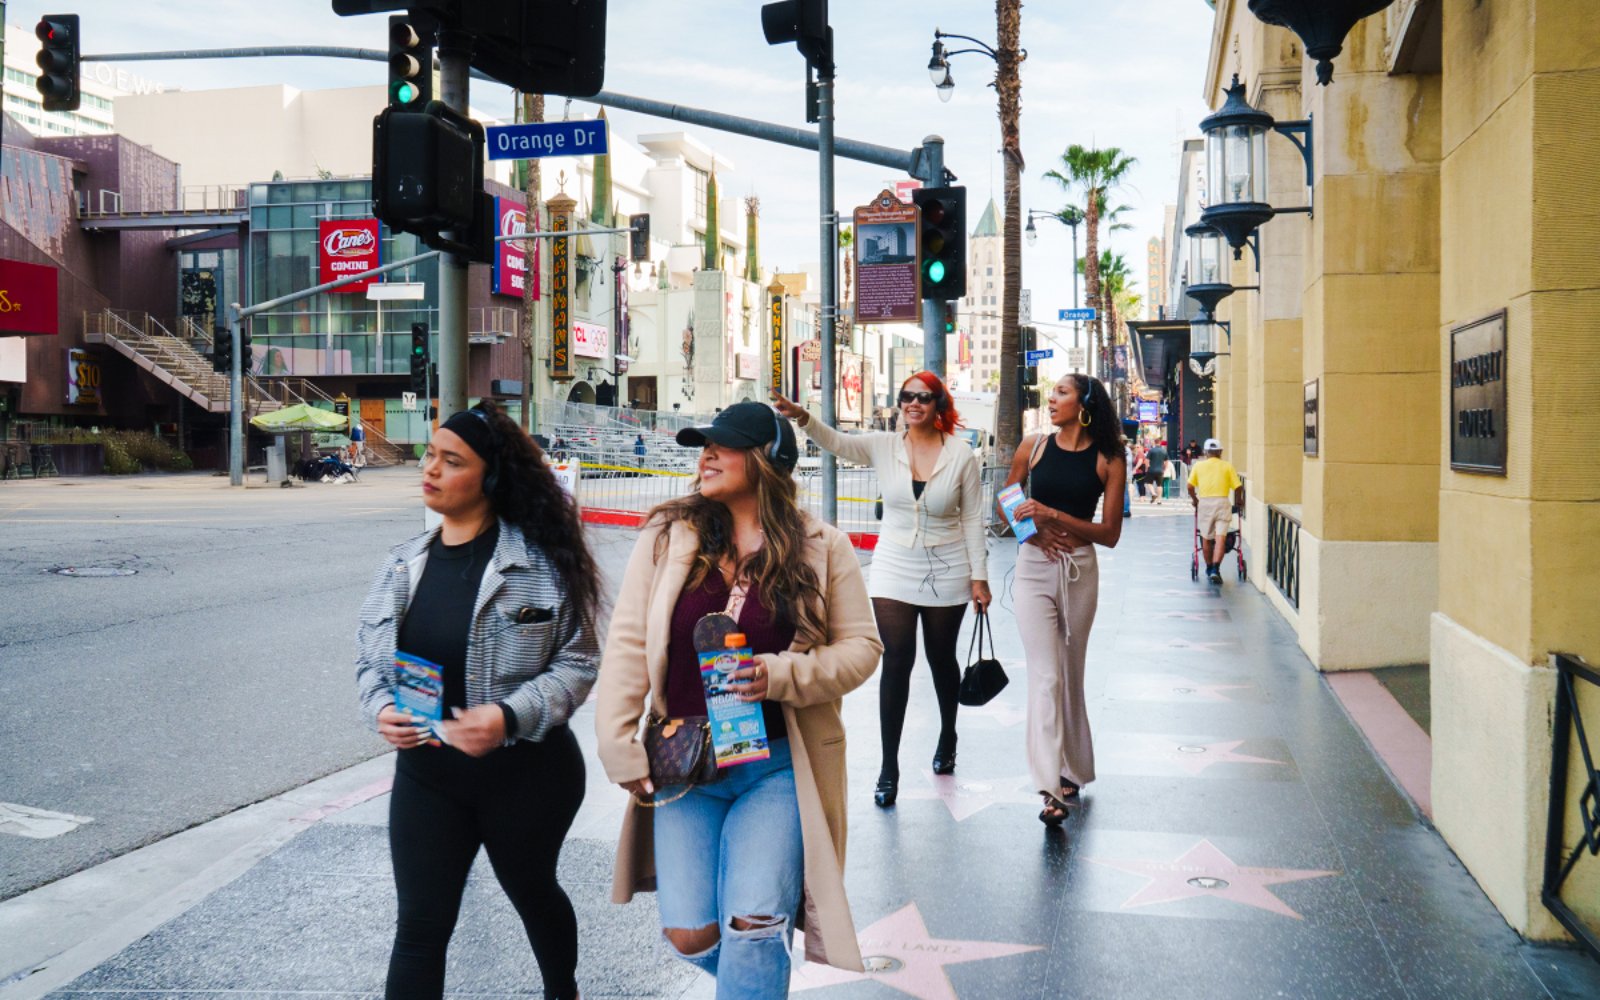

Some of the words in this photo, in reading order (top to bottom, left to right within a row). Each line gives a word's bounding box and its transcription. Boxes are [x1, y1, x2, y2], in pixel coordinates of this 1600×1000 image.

[497, 132, 565, 154] Orange
[574, 128, 596, 147] Dr
[326, 228, 373, 255] Cane's
[330, 260, 369, 271] COMING
[772, 301, 782, 388] CHINESE
[77, 362, 100, 388] $10
[1458, 408, 1495, 438] HOTEL
[901, 942, 963, 954] LANTZ
